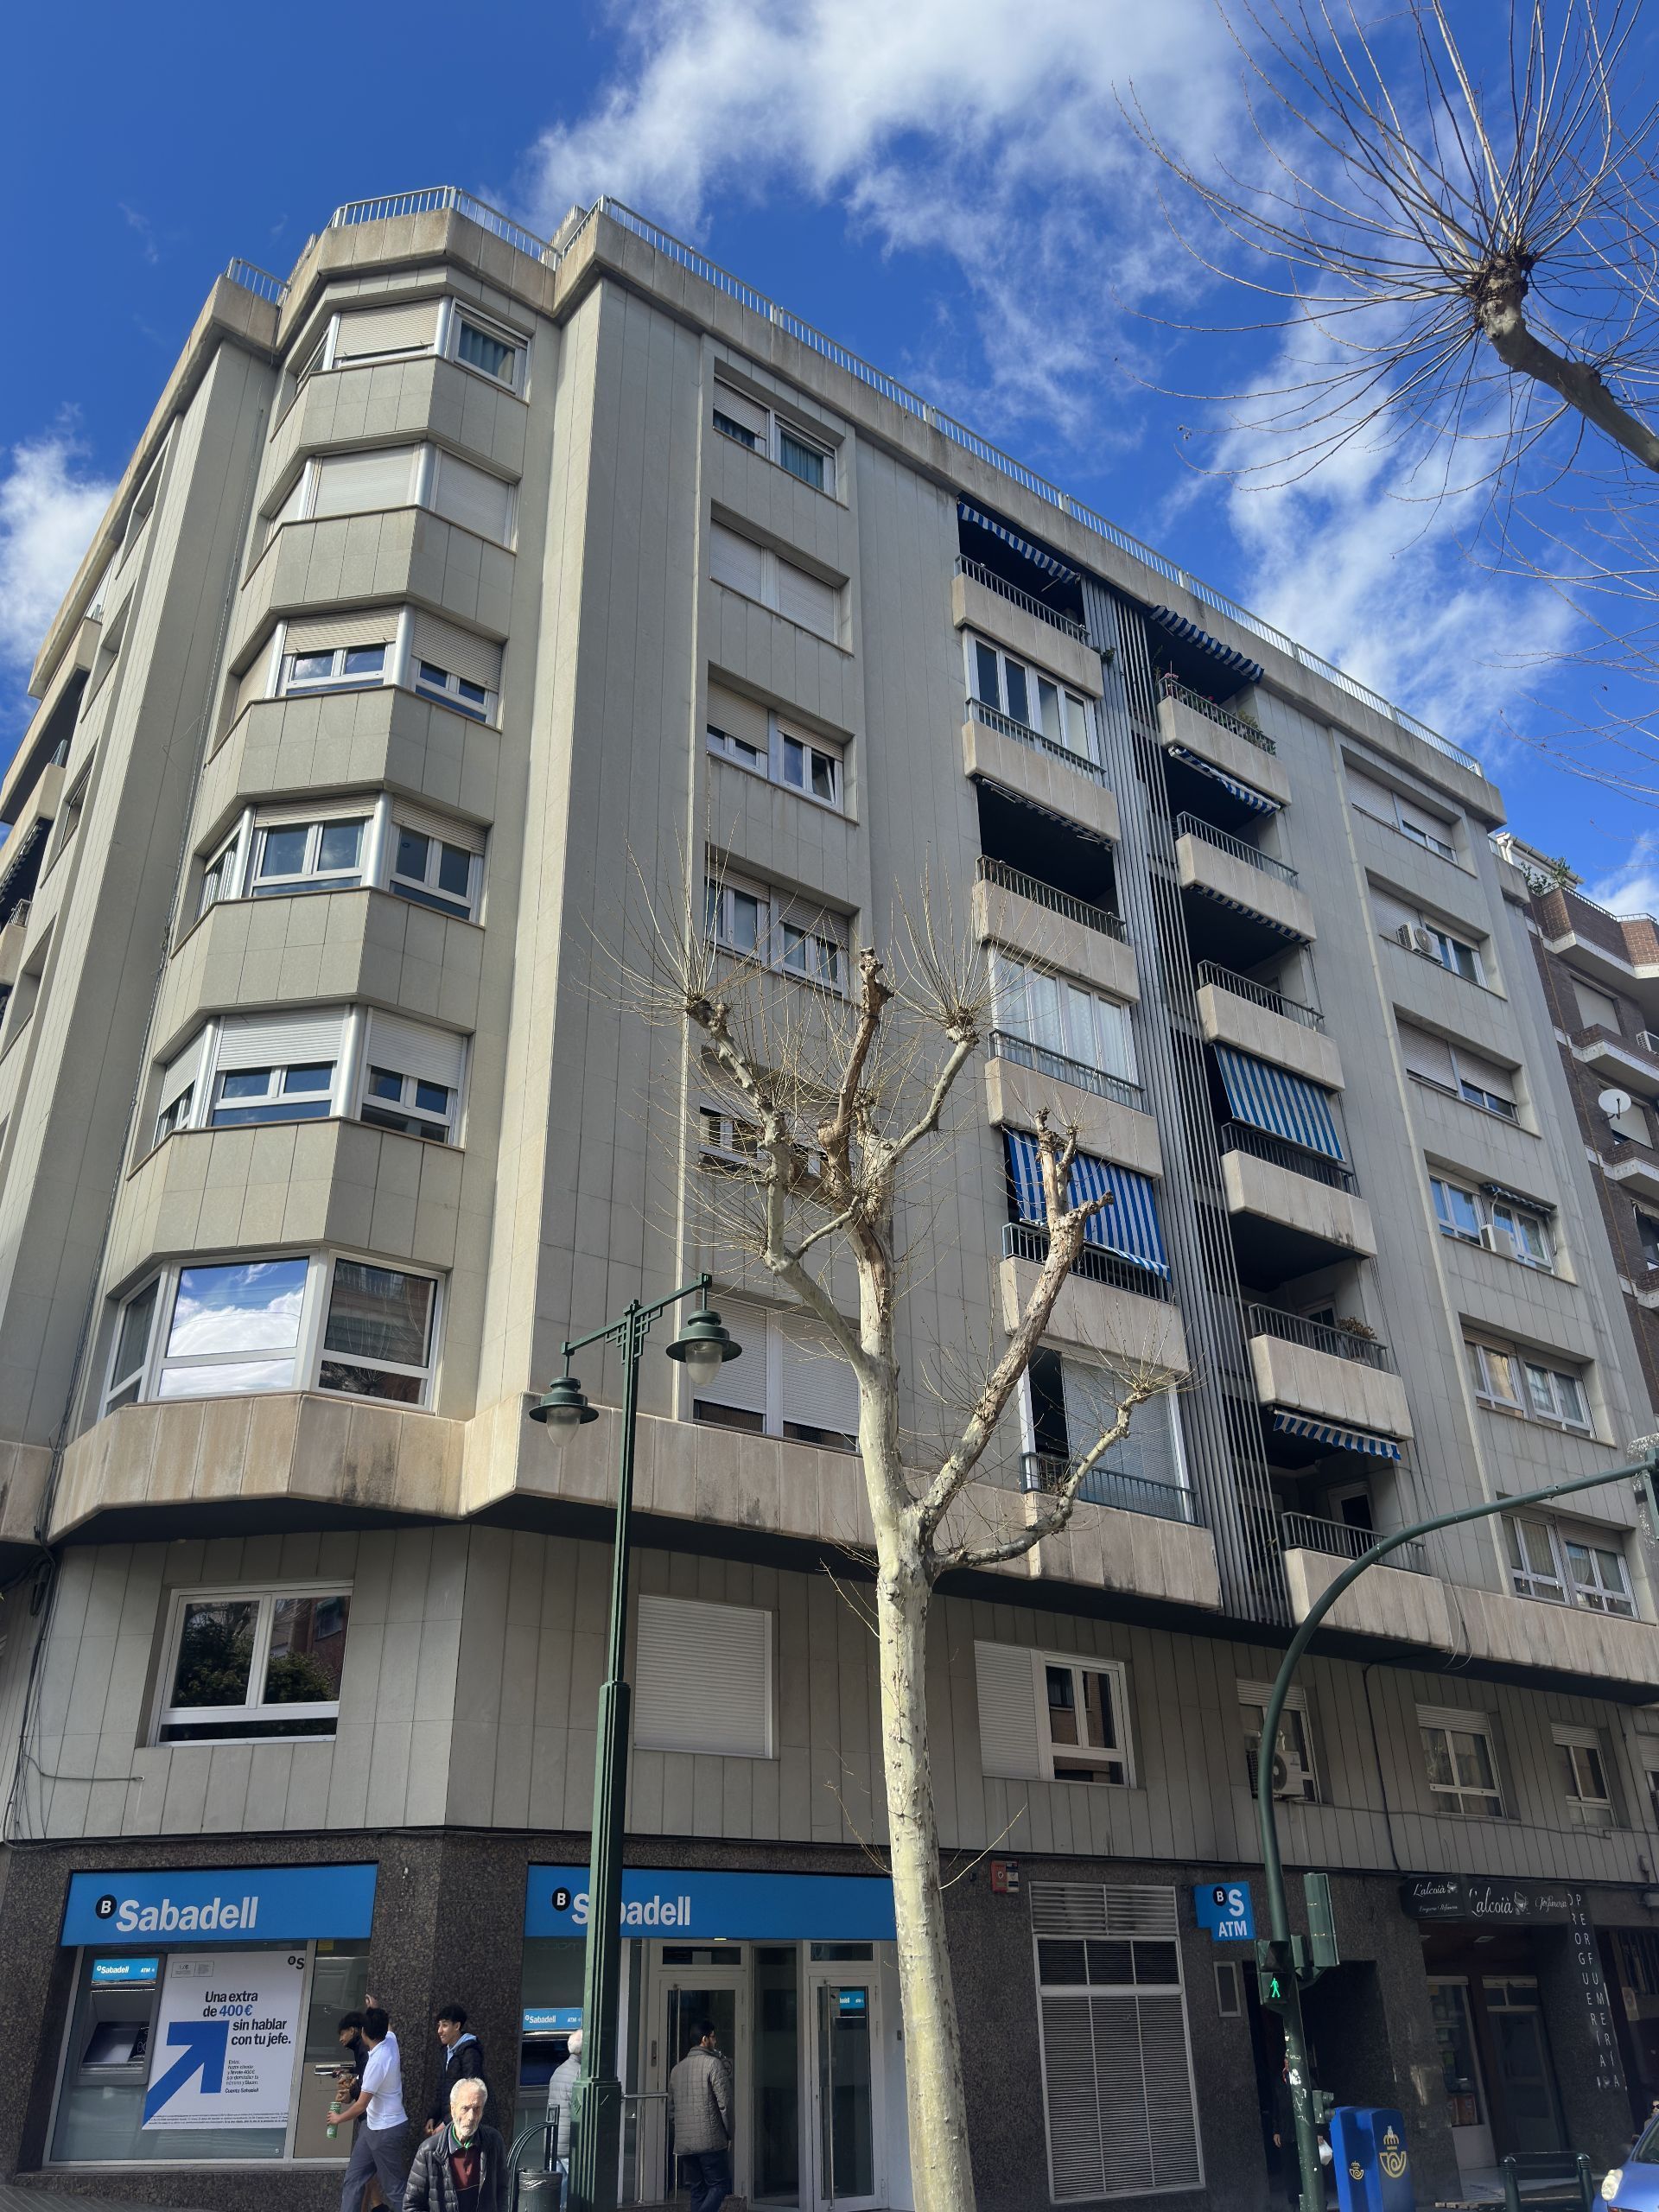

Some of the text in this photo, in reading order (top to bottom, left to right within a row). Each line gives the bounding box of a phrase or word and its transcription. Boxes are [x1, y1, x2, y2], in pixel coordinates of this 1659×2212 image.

[1216, 1889, 1244, 1916] B S
[100, 1896, 259, 1932] B Sabadell
[556, 1892, 691, 1927] B Sadell
[1218, 1920, 1248, 1937] ATM
[101, 1966, 130, 1974] Sabadell
[296, 1957, 305, 1970] S
[205, 1990, 258, 2003] Una extra
[203, 2005, 217, 2018] de
[232, 2018, 288, 2031] sin hablar
[529, 2014, 556, 2024] Sabadell
[231, 2032, 291, 2048] con tu jefe.
